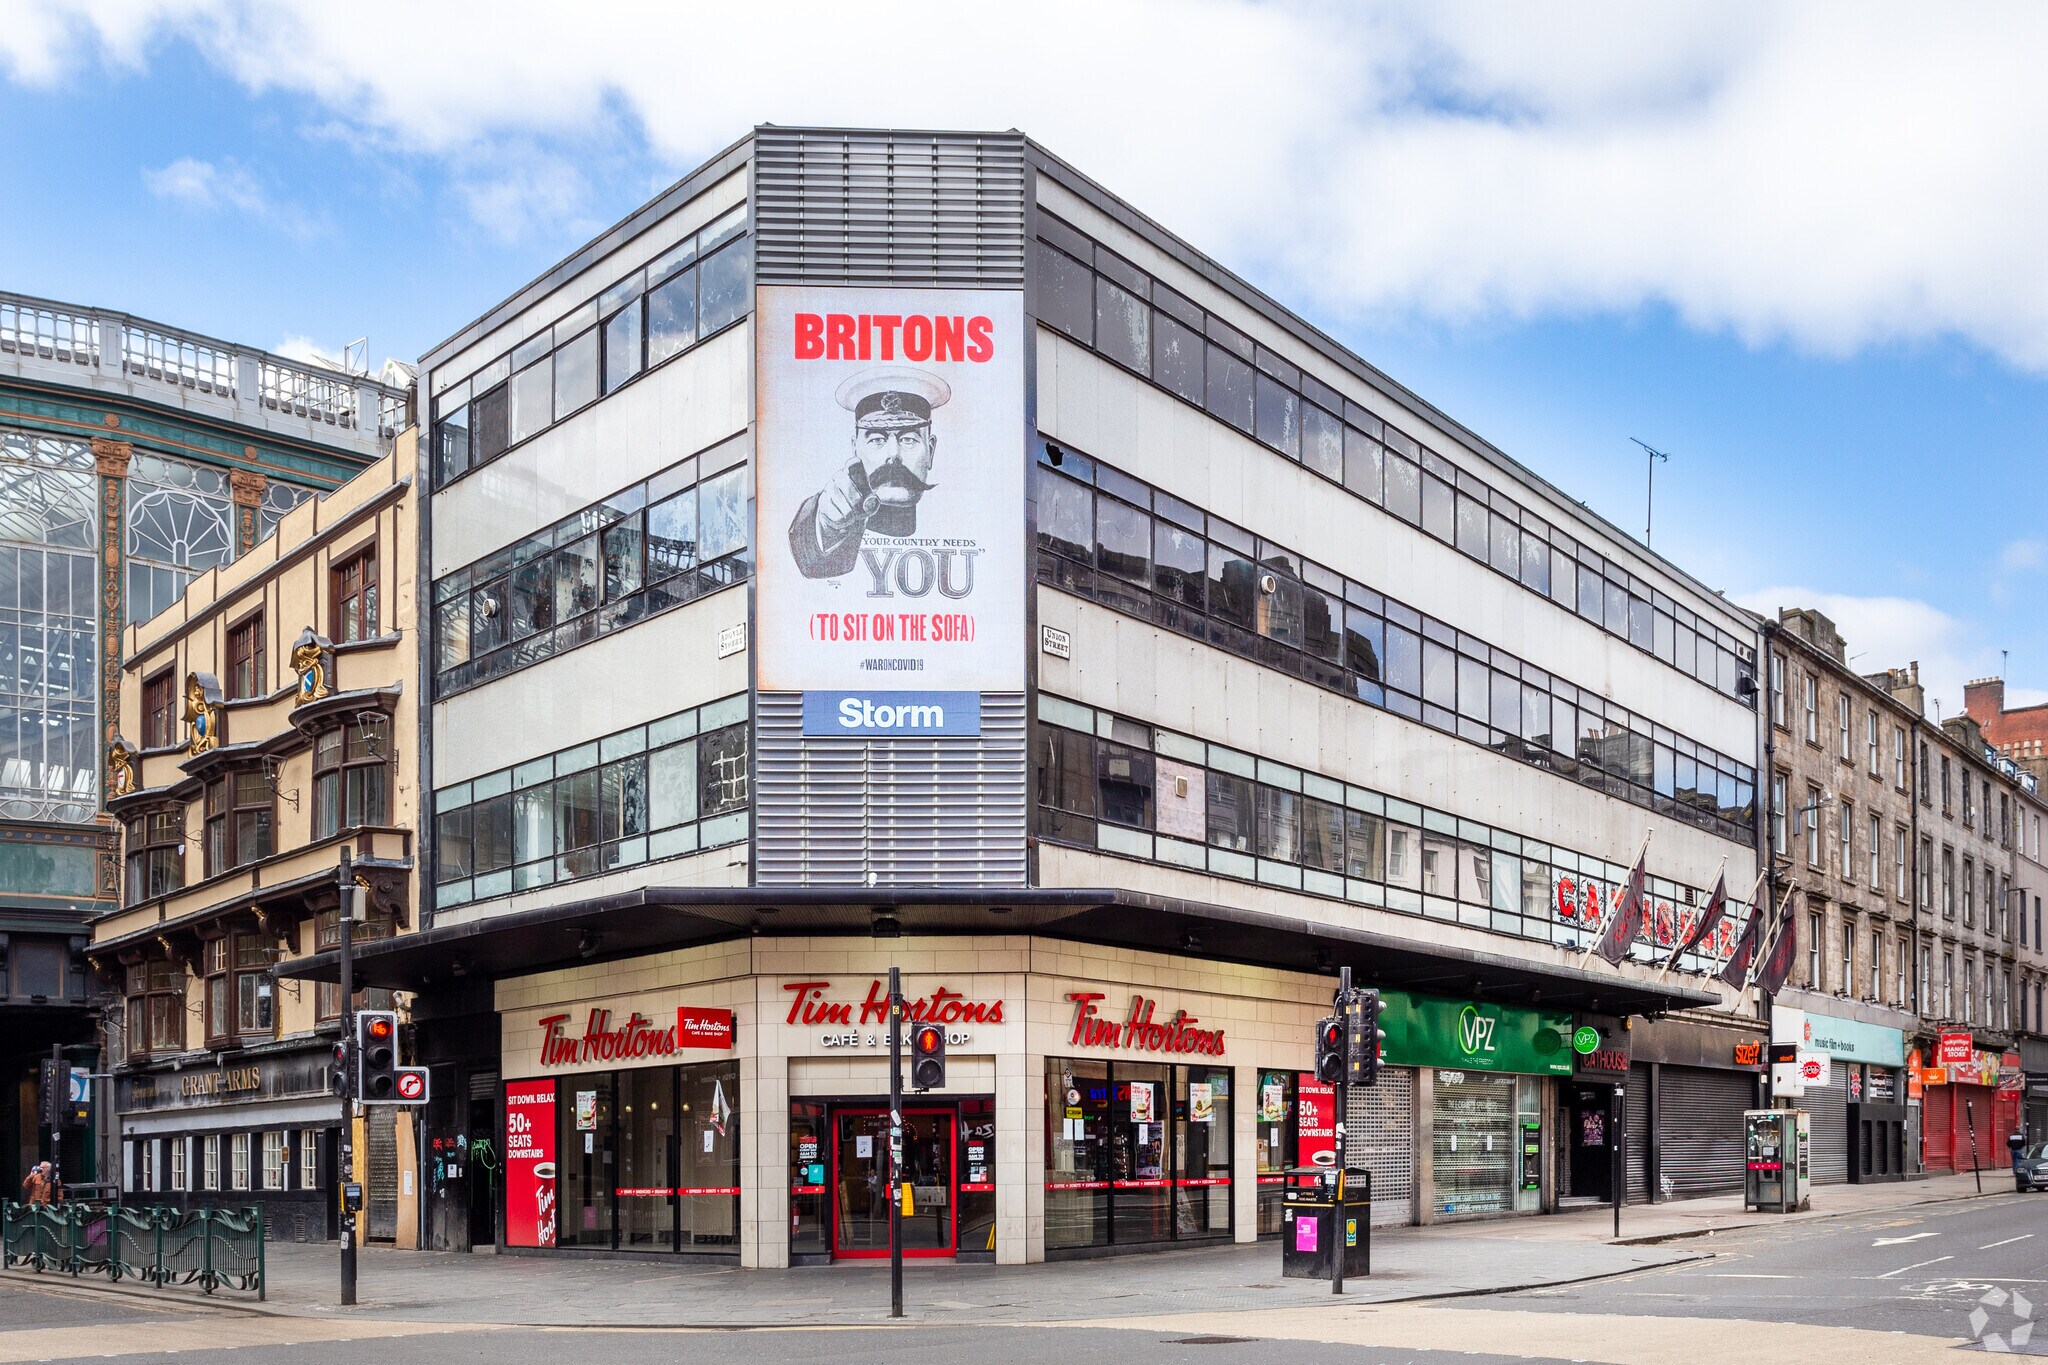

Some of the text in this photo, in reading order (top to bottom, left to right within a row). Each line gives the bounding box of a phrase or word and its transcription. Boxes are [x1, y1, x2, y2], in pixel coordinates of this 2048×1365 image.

[794, 313, 994, 363] BRITONS
[893, 538, 939, 547] COUNTRY
[943, 539, 976, 548] NEEDS
[843, 614, 868, 641] SIT
[872, 614, 895, 641] ON
[899, 614, 927, 641] THE
[1044, 638, 1068, 652] STREET
[859, 658, 924, 671] #WARONCOVID19
[838, 698, 944, 729] Storm
[783, 982, 852, 1025] Tim
[684, 1018, 730, 1032] Tim Hortons
[1067, 993, 1225, 1056] Tim Hortons
[1460, 1010, 1495, 1052] VPZ
[539, 1008, 675, 1066] Tim Hortons
[821, 1030, 858, 1047] CAFÉ
[866, 1034, 876, 1046] &
[1576, 1032, 1596, 1044] VPZ
[1814, 1038, 1828, 1048] music
[1840, 1041, 1854, 1052] books
[1583, 1050, 1628, 1070] CATHOUSE
[1735, 1039, 1760, 1064] size?
[181, 1072, 221, 1096] GRANT
[226, 1066, 261, 1090] ARMS
[508, 1096, 516, 1105] SIT
[1300, 1101, 1318, 1116] 50+
[509, 1113, 531, 1132] 50+
[1299, 1117, 1318, 1127] SEATS
[508, 1134, 532, 1147] SEATS
[1299, 1129, 1333, 1137] DOWNSTAIRS
[508, 1149, 543, 1158] DOWNSTAIRS
[536, 1185, 555, 1215] Tim
